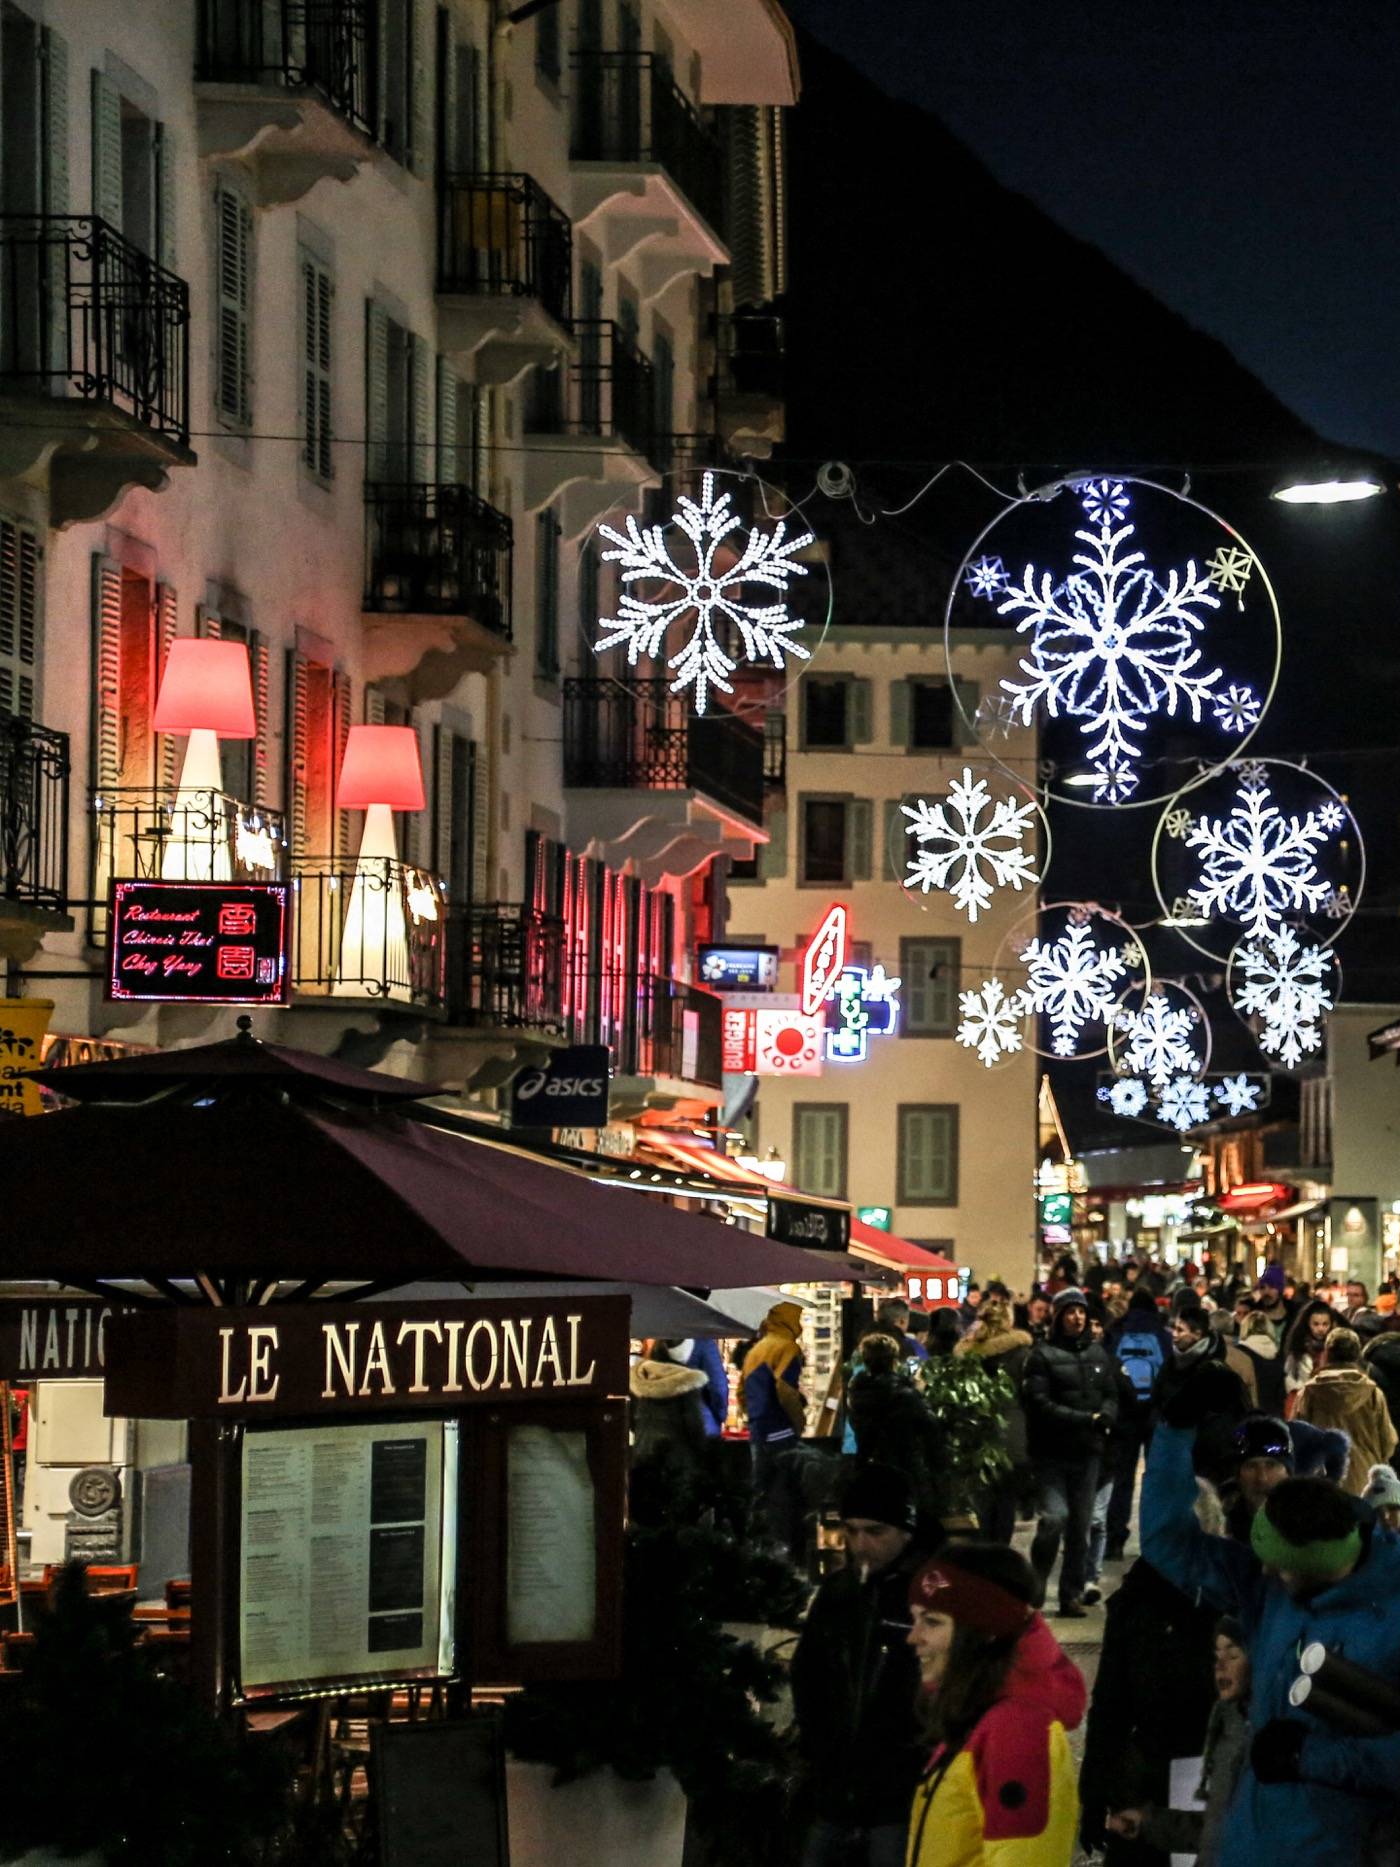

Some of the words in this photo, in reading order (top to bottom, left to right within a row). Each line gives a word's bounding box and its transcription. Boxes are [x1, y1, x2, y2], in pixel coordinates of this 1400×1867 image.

[124, 905, 200, 921] Restaurant
[724, 1011, 746, 1070] BURGER
[218, 1325, 279, 1404] LE
[321, 1315, 597, 1398] NATIONAL
